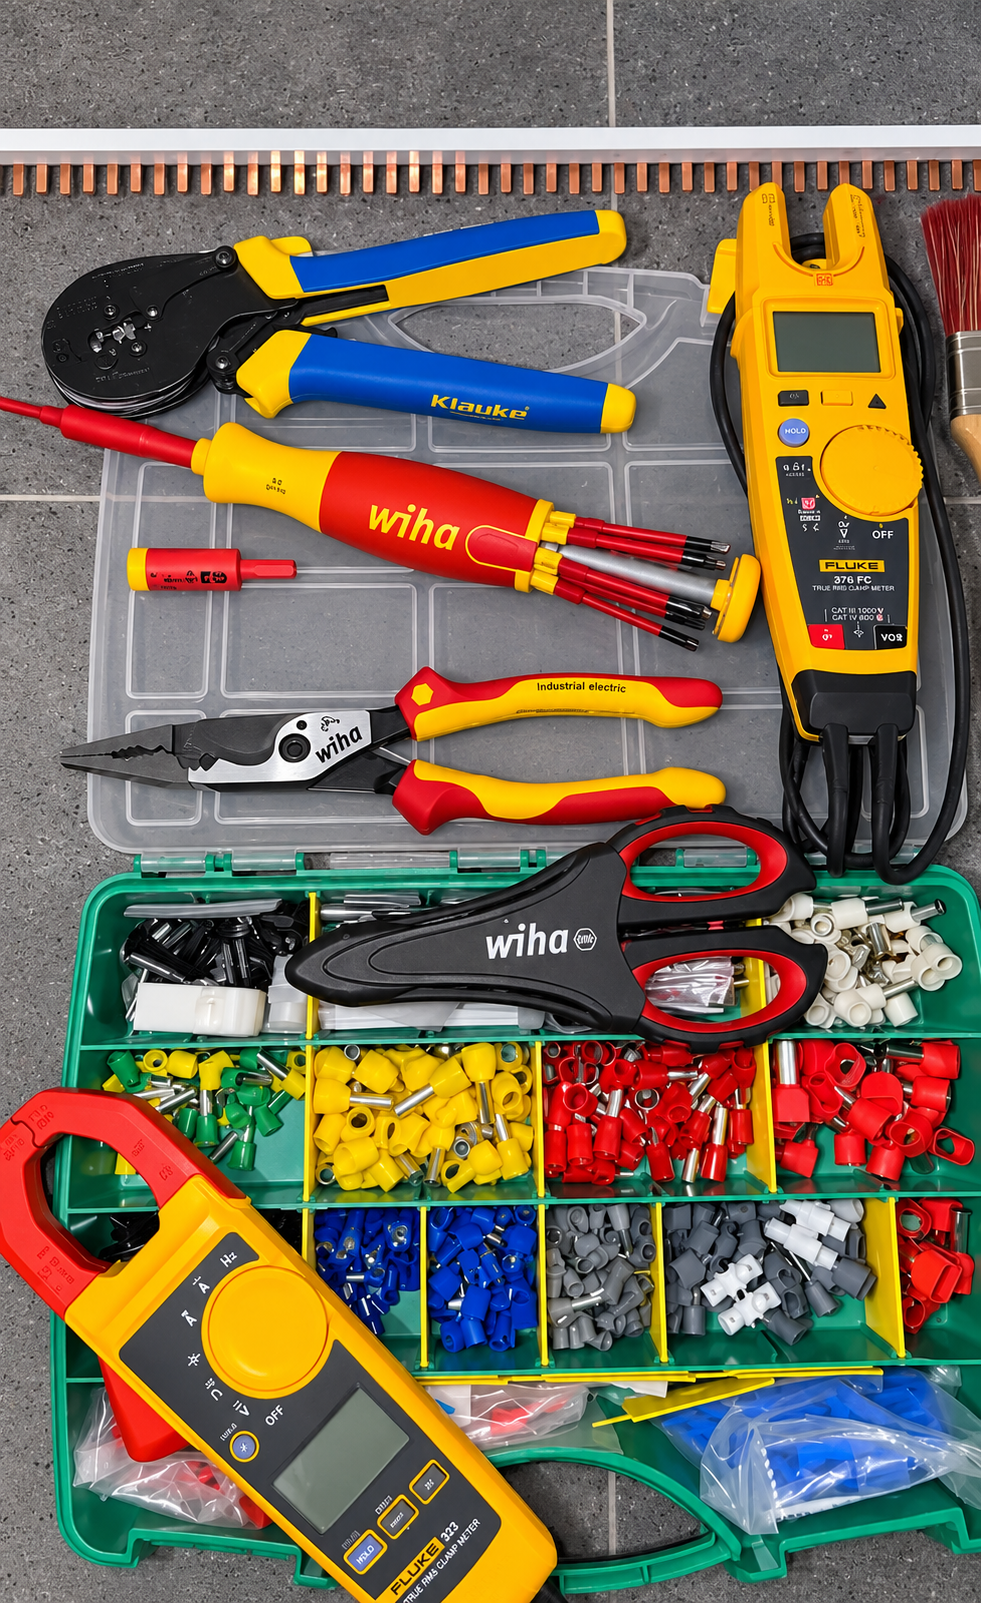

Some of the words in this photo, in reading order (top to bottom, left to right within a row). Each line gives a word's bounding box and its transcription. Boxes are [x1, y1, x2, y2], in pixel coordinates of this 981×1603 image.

[369, 504, 460, 551] wiha
[872, 530, 894, 539] OFF
[825, 562, 878, 570] FLUKE
[857, 576, 872, 584] FC
[536, 681, 585, 692] Industrial
[588, 682, 627, 693] electric
[315, 725, 363, 764] wiha
[486, 922, 569, 960] wiha
[265, 1405, 284, 1426] OFF
[390, 1543, 439, 1596] FLUKE
